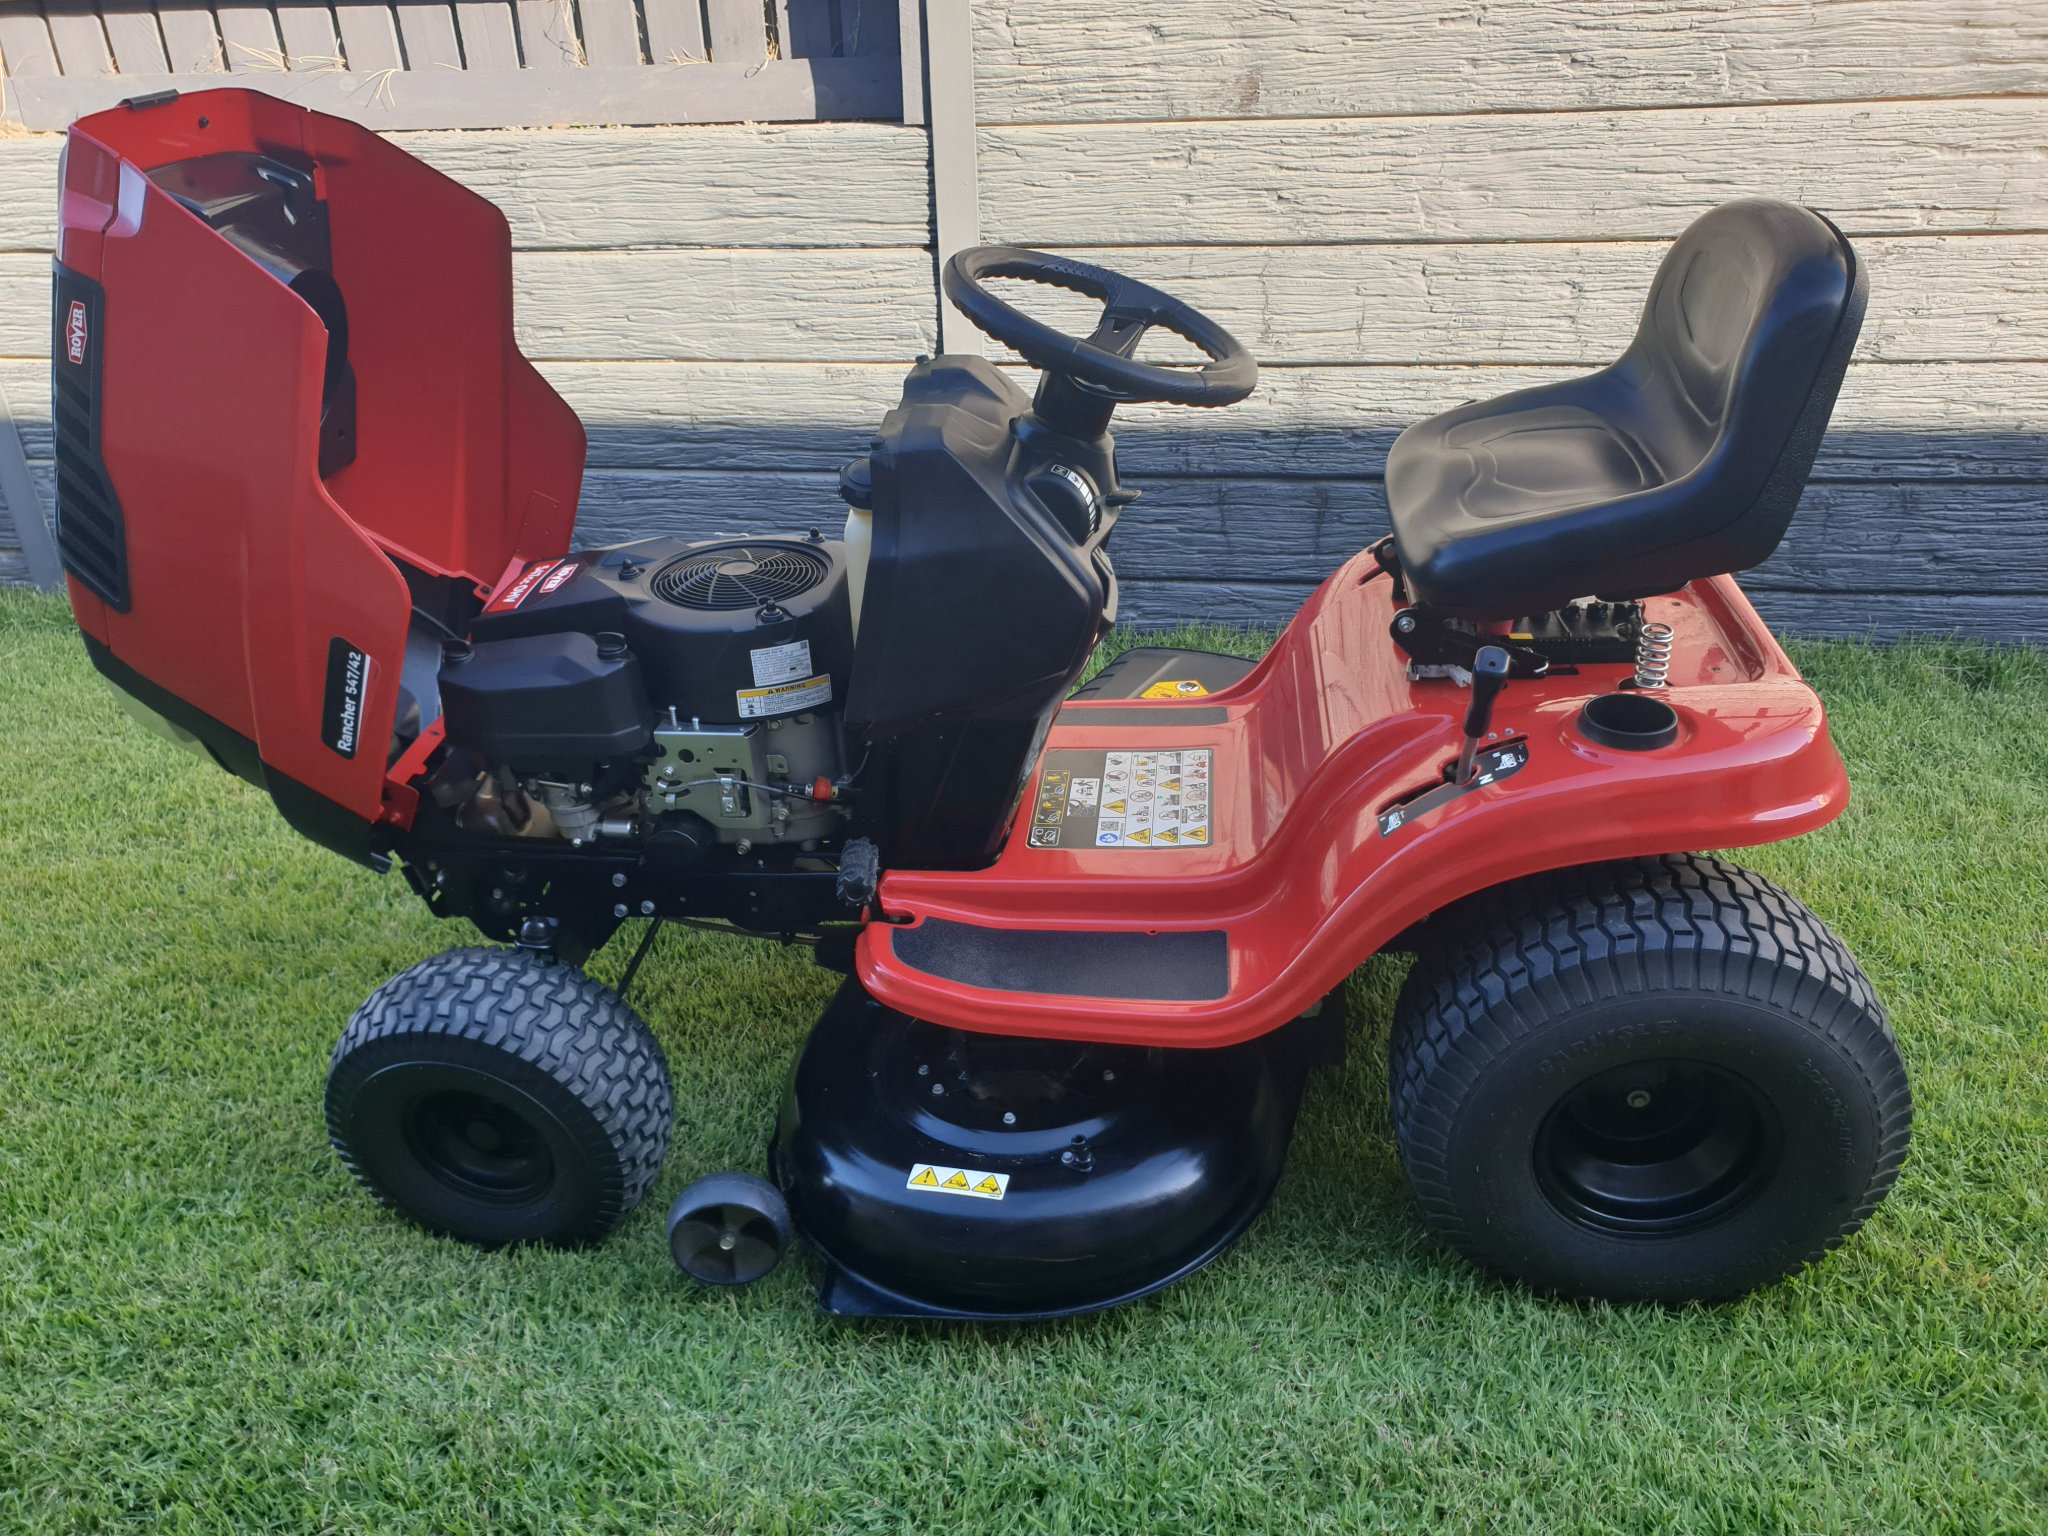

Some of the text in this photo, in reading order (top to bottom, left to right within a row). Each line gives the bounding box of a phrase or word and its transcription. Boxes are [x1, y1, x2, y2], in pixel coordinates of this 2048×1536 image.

[70, 309, 85, 358] ROVER
[338, 652, 361, 752] Rancher 547/42
[775, 683, 806, 692] WARNING
[1478, 773, 1494, 785] N
